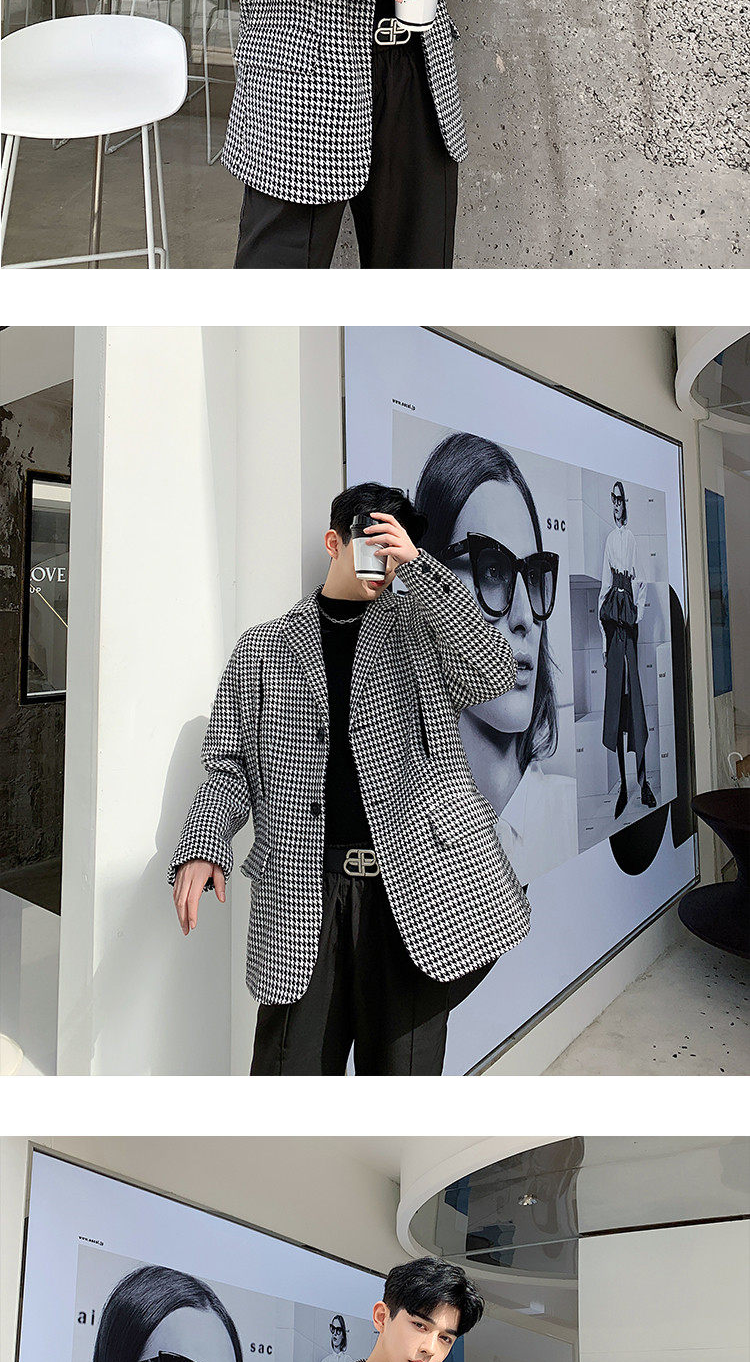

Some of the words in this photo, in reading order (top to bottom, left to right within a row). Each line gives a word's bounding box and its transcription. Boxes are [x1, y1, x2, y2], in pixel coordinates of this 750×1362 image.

[546, 518, 567, 532] sac
[30, 567, 66, 582] OVE
[77, 1309, 96, 1326] ai
[250, 1342, 273, 1355] sac
